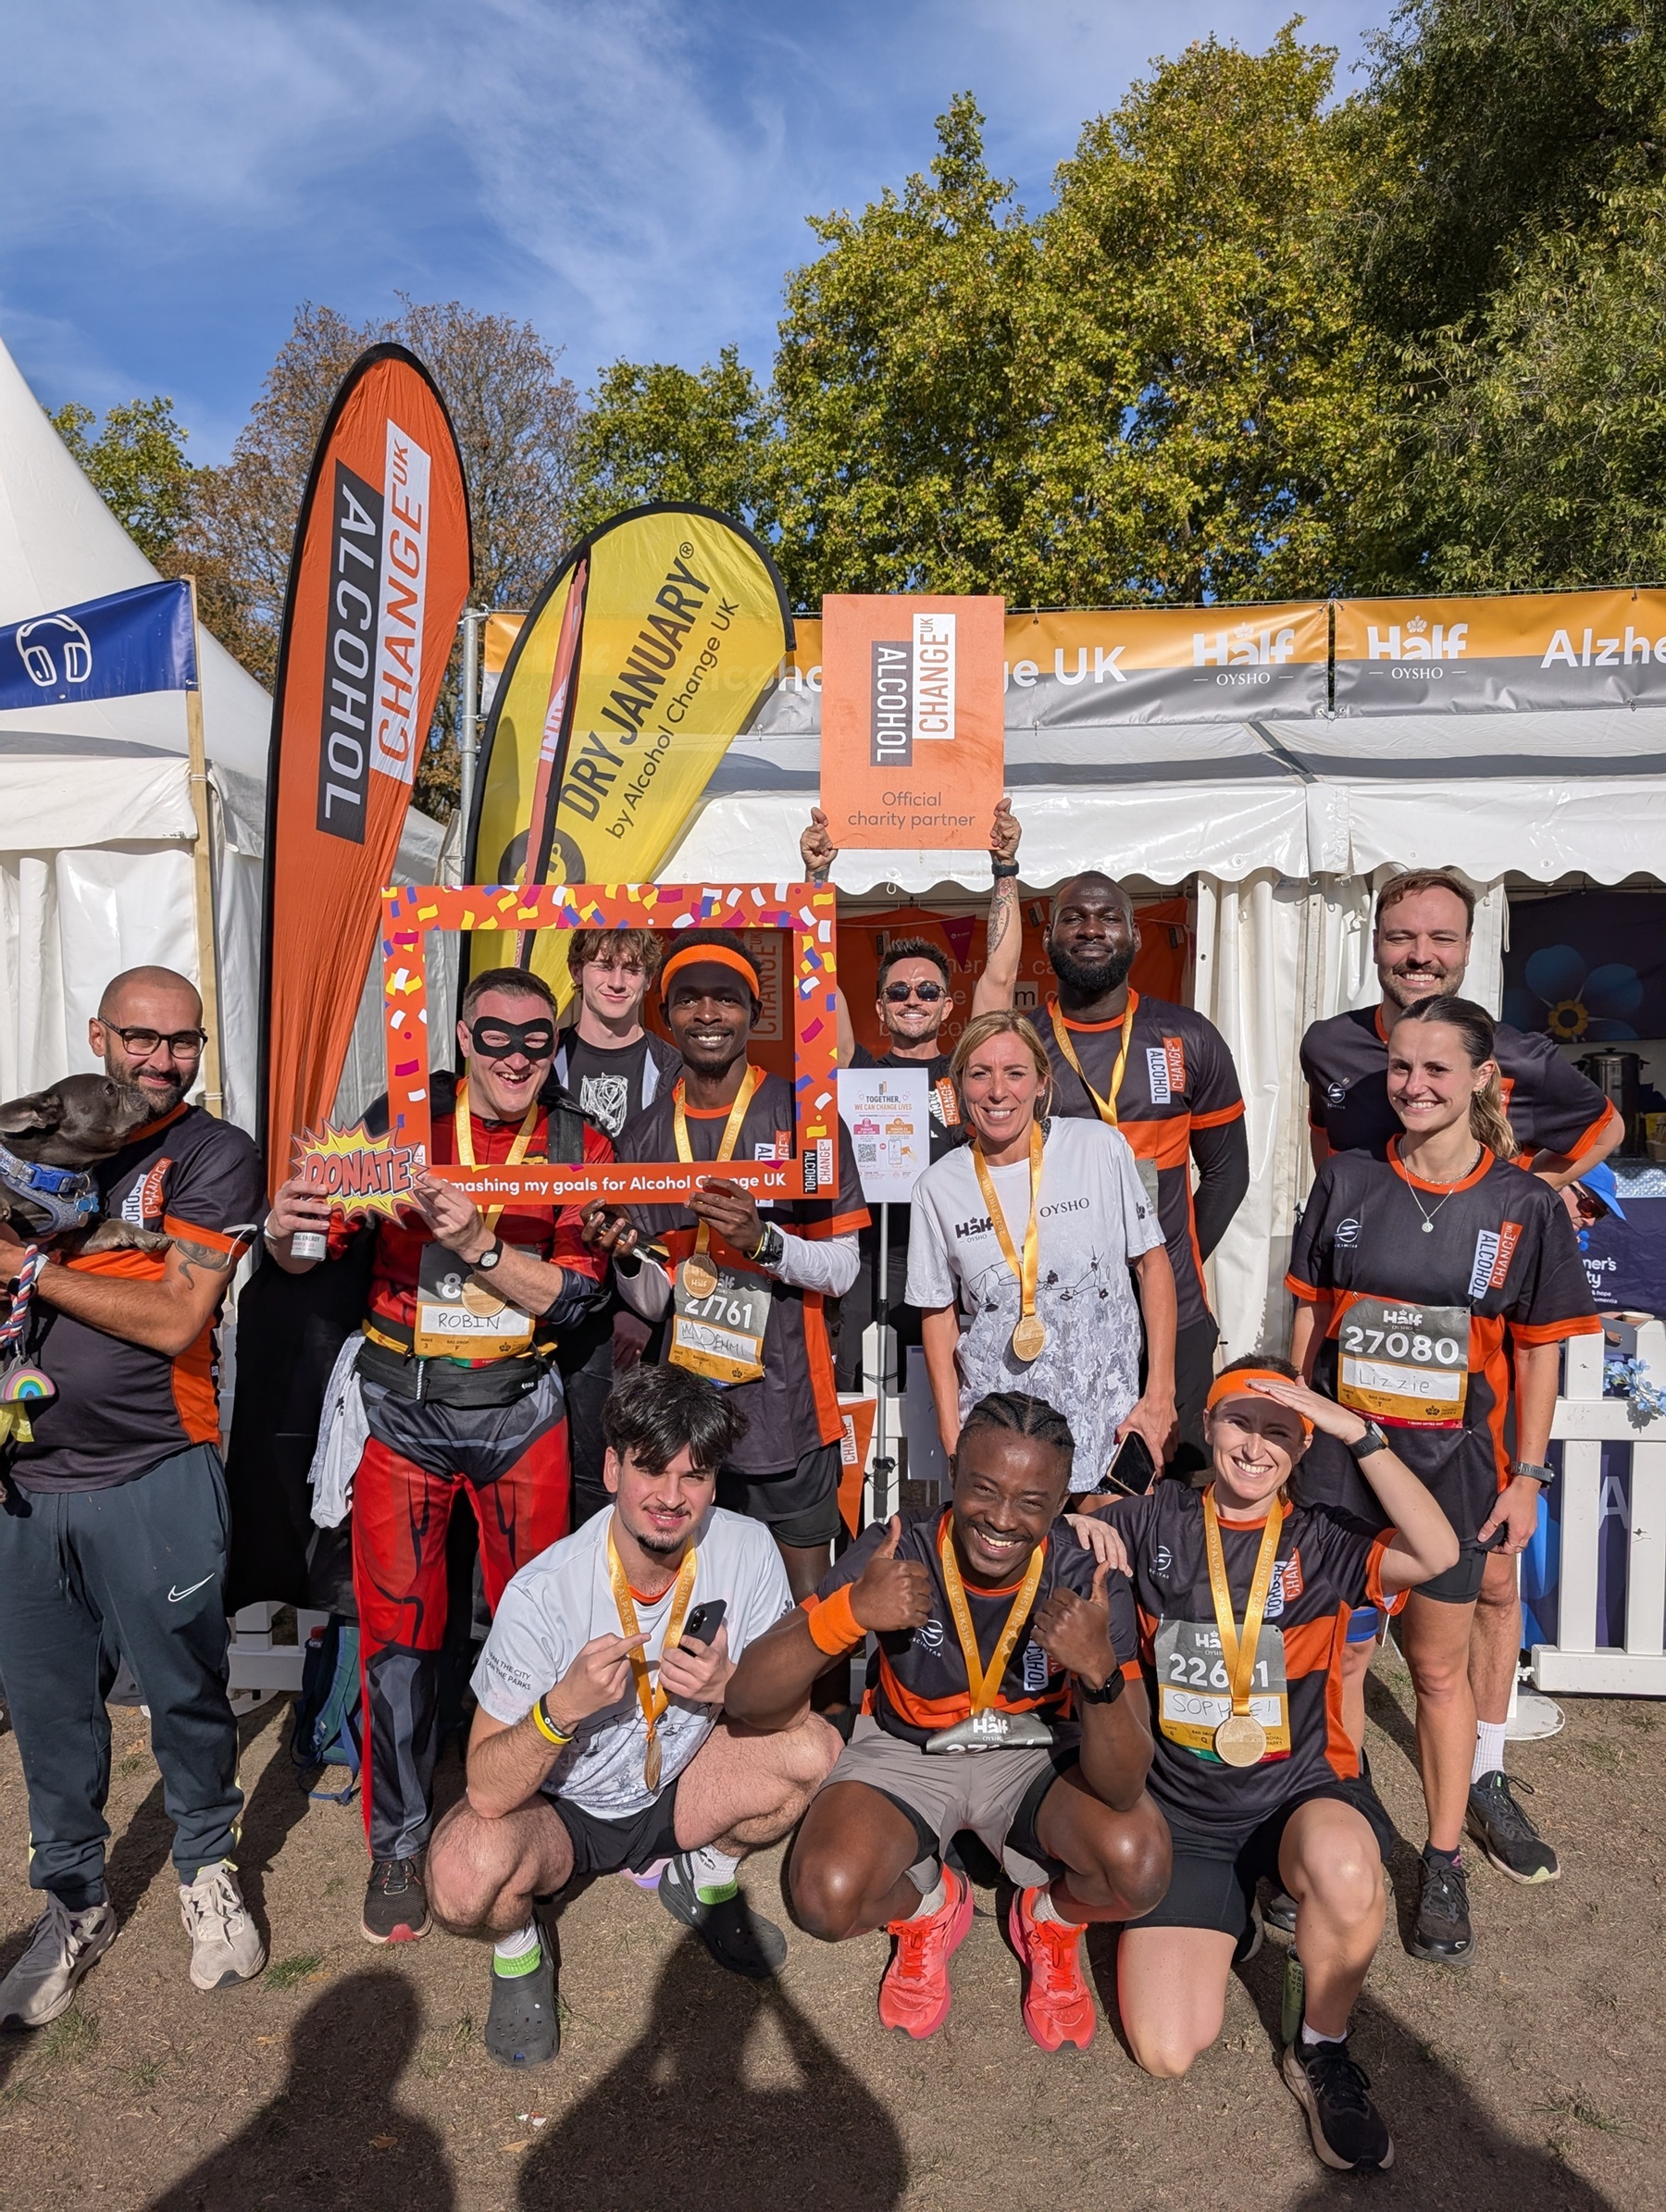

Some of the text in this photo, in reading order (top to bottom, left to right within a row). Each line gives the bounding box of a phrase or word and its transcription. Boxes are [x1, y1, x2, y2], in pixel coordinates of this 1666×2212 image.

[378, 441, 423, 764] CHANGE UK
[324, 483, 377, 819] ALCOHOL
[1192, 628, 1295, 667] Half
[1366, 623, 1469, 661] Half
[673, 650, 822, 693] Alcoho
[1054, 645, 1127, 687] UK
[917, 617, 950, 734] CHANGE UK
[1215, 671, 1271, 687] OYSHO
[1390, 665, 1444, 680] OYSHO
[604, 596, 740, 839] by Alcohol Change UK
[876, 646, 908, 763] ALCOHOL
[559, 730, 625, 823] DRY
[881, 790, 942, 807] Official
[847, 810, 976, 830] charity partner
[1149, 1050, 1168, 1102] ALCOHOL
[1171, 1045, 1184, 1091] CHANGE
[866, 1095, 901, 1104] TOGETHER,
[940, 1083, 957, 1123] CHANGE
[724, 1106, 743, 1150] FINISHER
[304, 1149, 413, 1199] DONATE
[803, 1151, 816, 1193] ALCOHOL
[819, 1145, 831, 1183] CHANGE
[144, 1166, 167, 1214] CHANGE
[441, 1173, 787, 1196] mashing my goals for Alcohol Cnge UK
[980, 1172, 999, 1213] FINISHER
[1039, 1197, 1090, 1219] OYSHO
[955, 1217, 994, 1239] Half
[966, 1233, 988, 1243] OYSHO
[1472, 1232, 1498, 1295] ALCOHOL
[1491, 1232, 1517, 1286] CHANGE
[718, 1274, 736, 1289] alf
[438, 1312, 501, 1330] ROBIN
[684, 1292, 753, 1330] 27761
[1382, 1310, 1424, 1326] Half
[1344, 1325, 1460, 1365] 27080
[1359, 1367, 1431, 1394] Lizzie
[1250, 1538, 1274, 1617] 2026 FINISHER
[669, 1561, 693, 1646] 2026 FINISHER
[1011, 1577, 1036, 1628] FINISHER
[913, 1637, 941, 1658] SCIMITAR
[1194, 1633, 1222, 1648] Ha
[485, 1658, 531, 1691] RAN THE PARKS
[500, 1660, 514, 1673] THE
[514, 1669, 531, 1680] CITY
[1172, 1693, 1272, 1718] SOPHE!
[973, 1718, 1009, 1735] Half
[1200, 1736, 1208, 1745] Q
